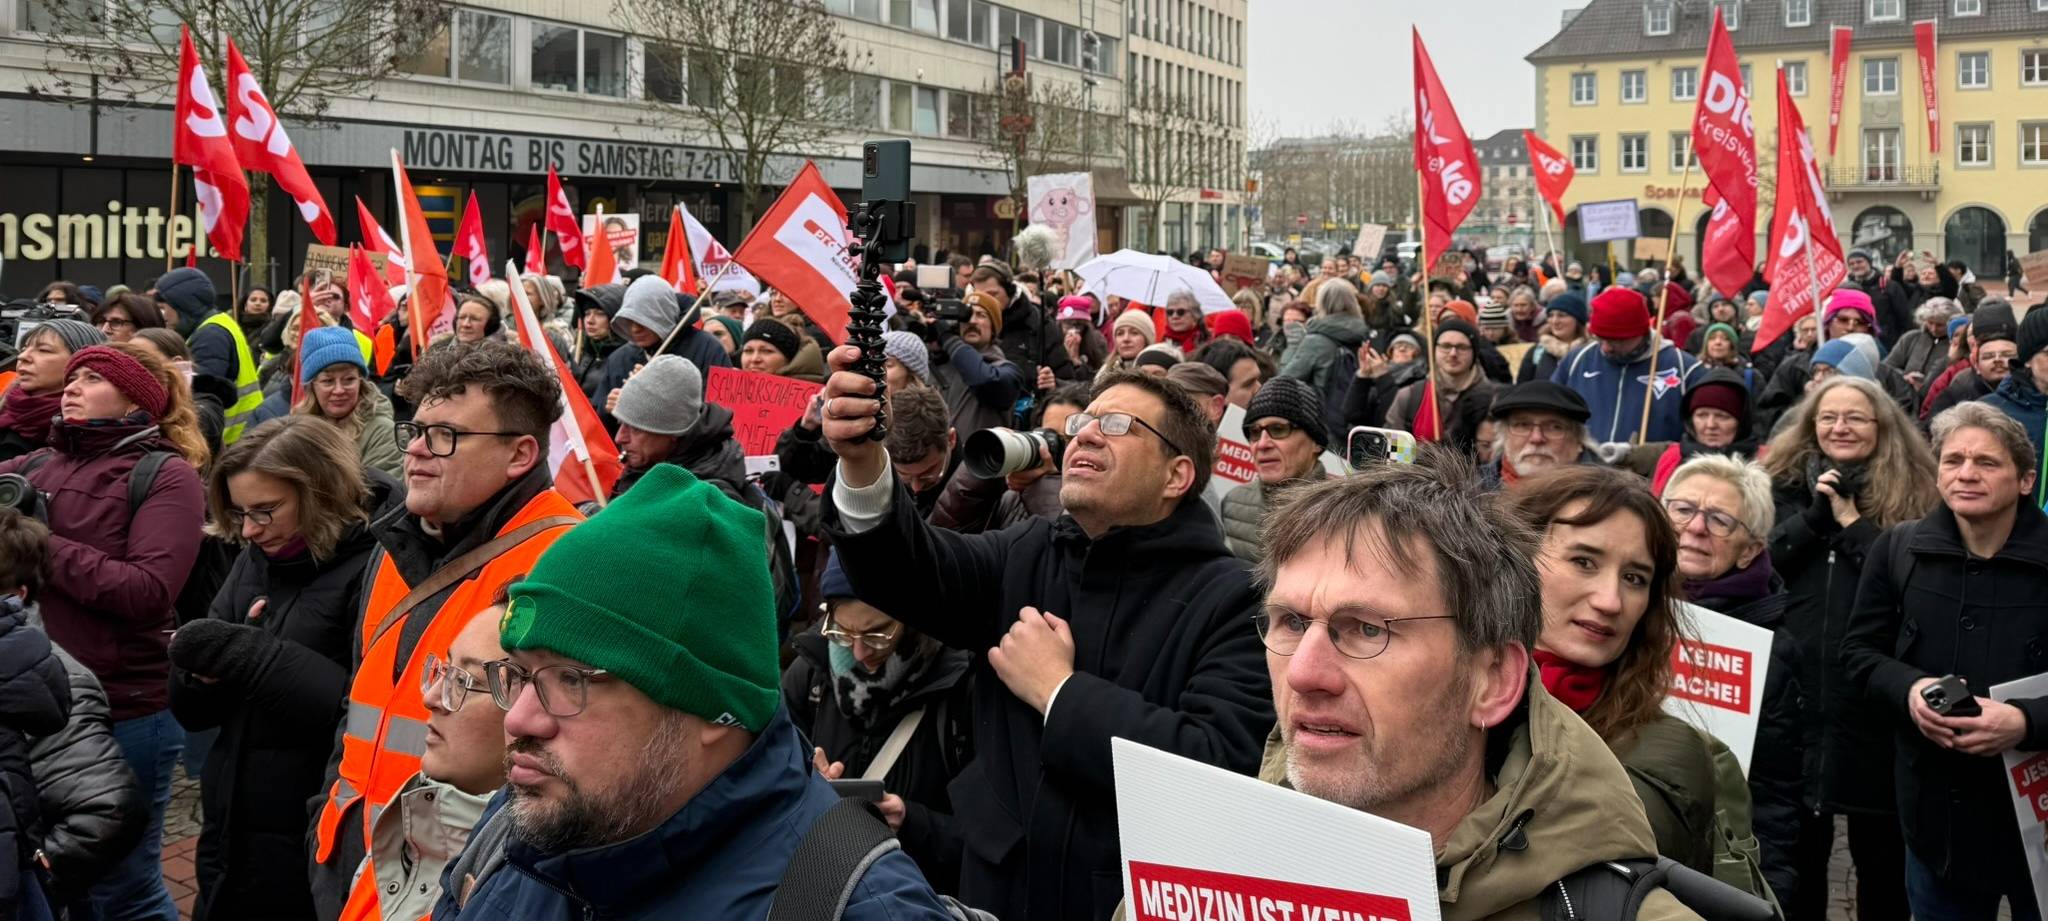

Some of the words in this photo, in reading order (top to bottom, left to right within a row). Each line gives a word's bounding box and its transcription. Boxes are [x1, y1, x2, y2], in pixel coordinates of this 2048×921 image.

[403, 130, 513, 171] MONTAG
[528, 138, 565, 174] BIS
[578, 142, 674, 178] SAMSTAG
[685, 151, 721, 180] 7-21
[1679, 645, 1744, 676] KEINE
[1139, 878, 1247, 921] MEDIZIN
